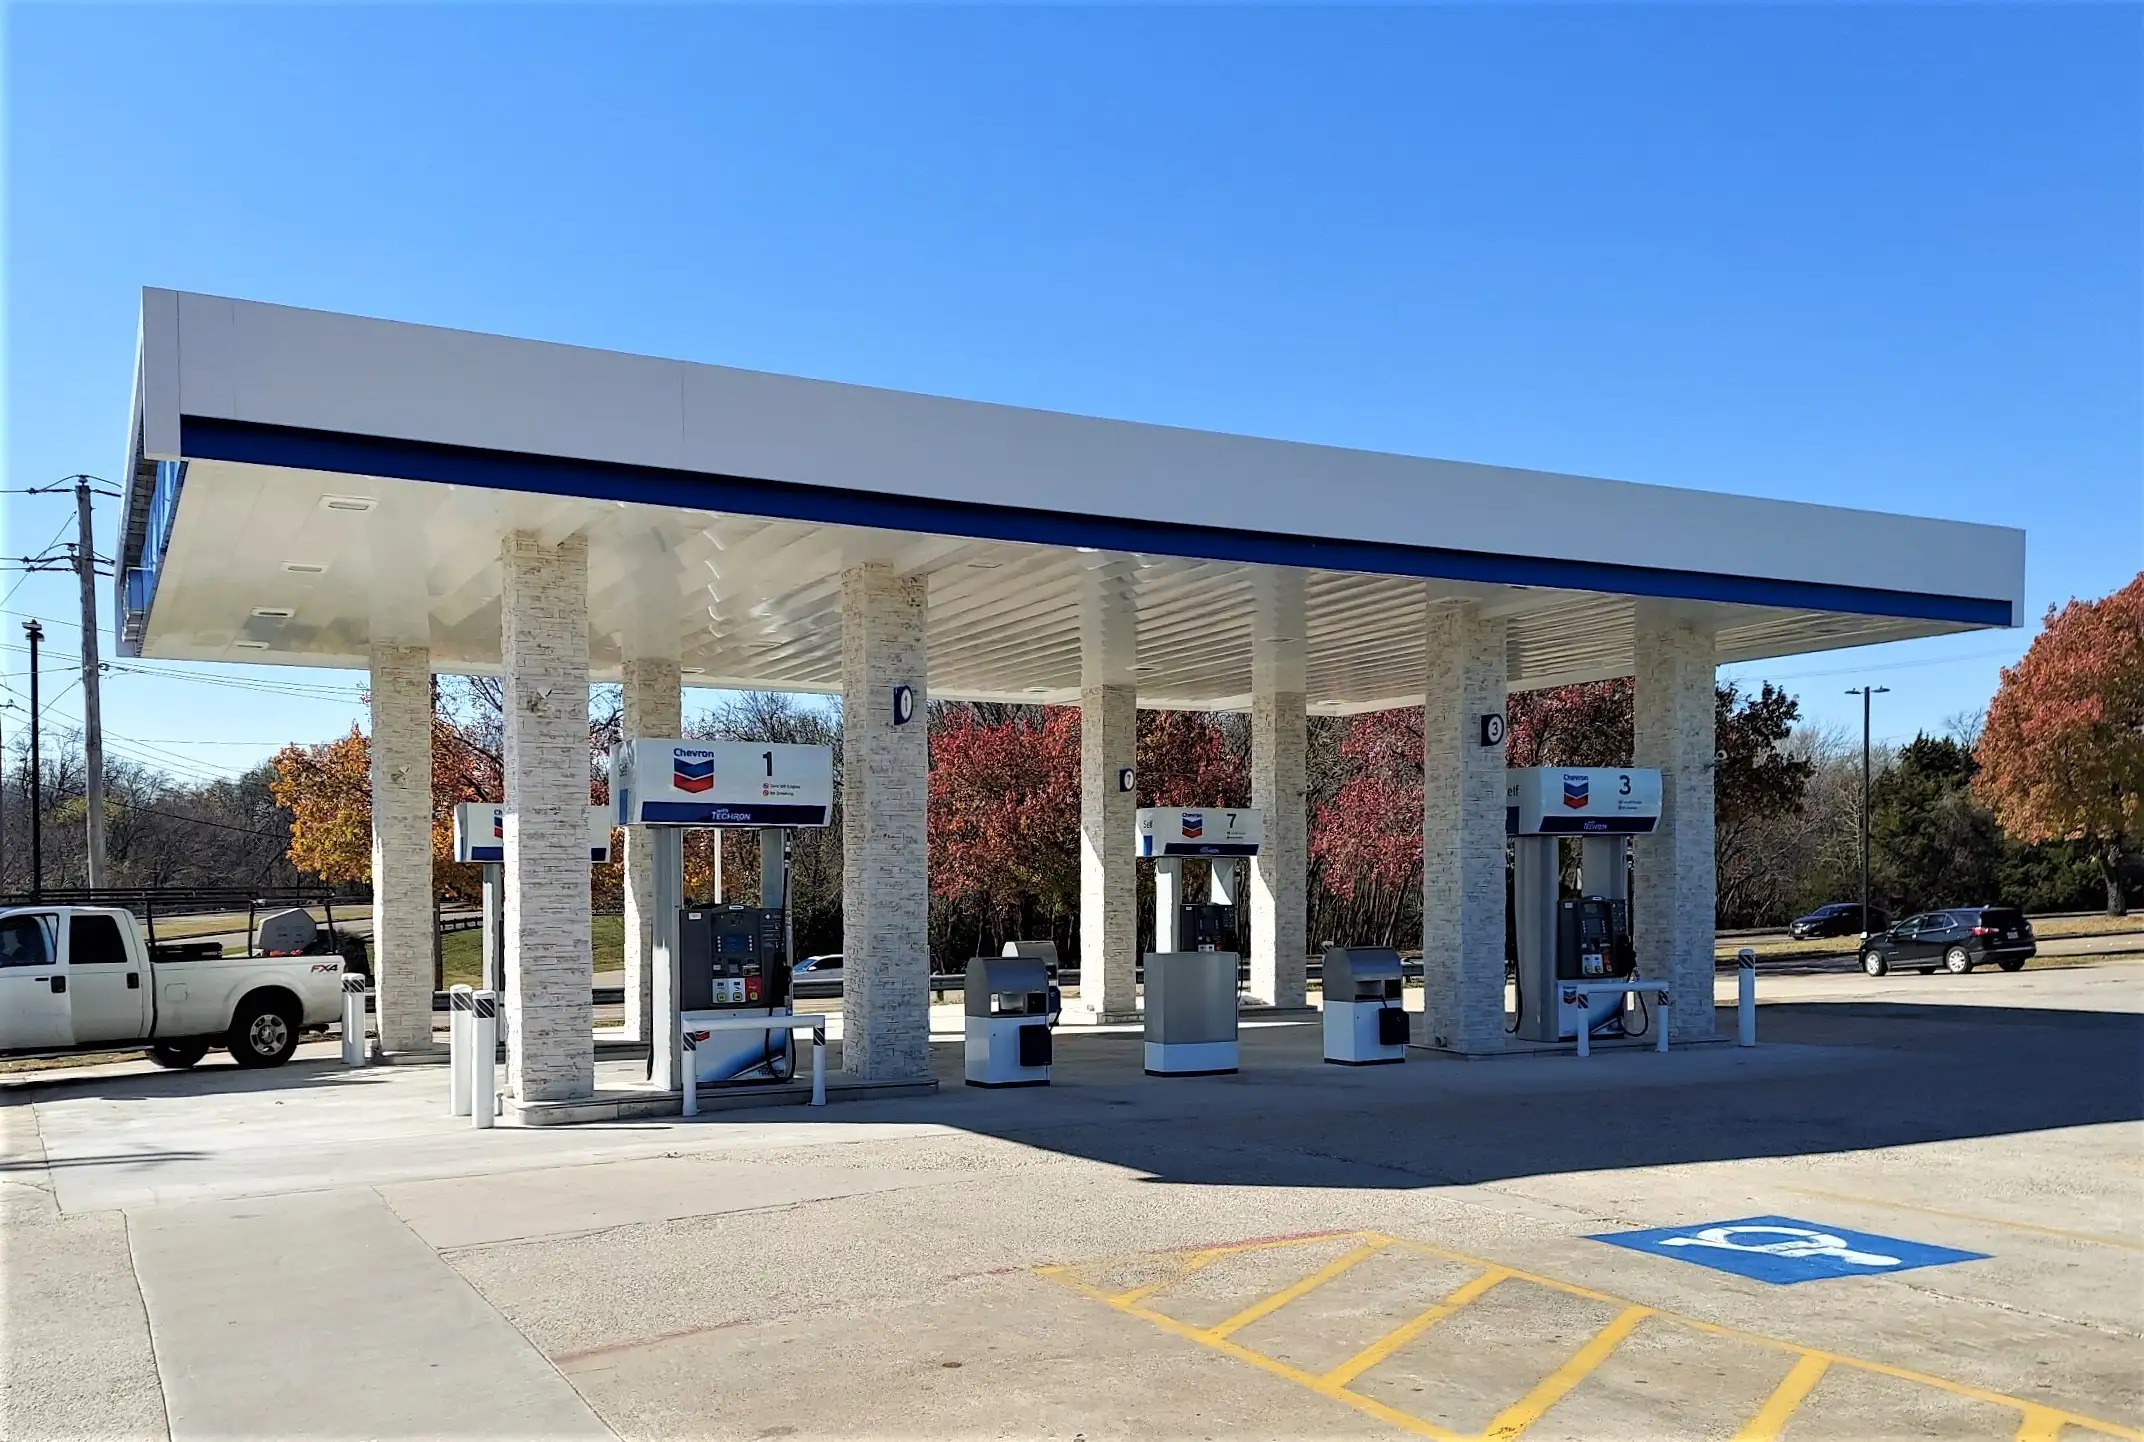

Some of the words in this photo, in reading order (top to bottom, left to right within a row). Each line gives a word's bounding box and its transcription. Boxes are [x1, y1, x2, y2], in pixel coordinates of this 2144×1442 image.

[1491, 721, 1499, 736] 3
[673, 748, 715, 758] Chevron
[762, 751, 773, 776] 1
[1507, 784, 1519, 796] elf
[1618, 774, 1632, 795] 3
[711, 811, 751, 821] TECHRON
[1226, 813, 1237, 828] 7
[311, 964, 337, 972] FX4
